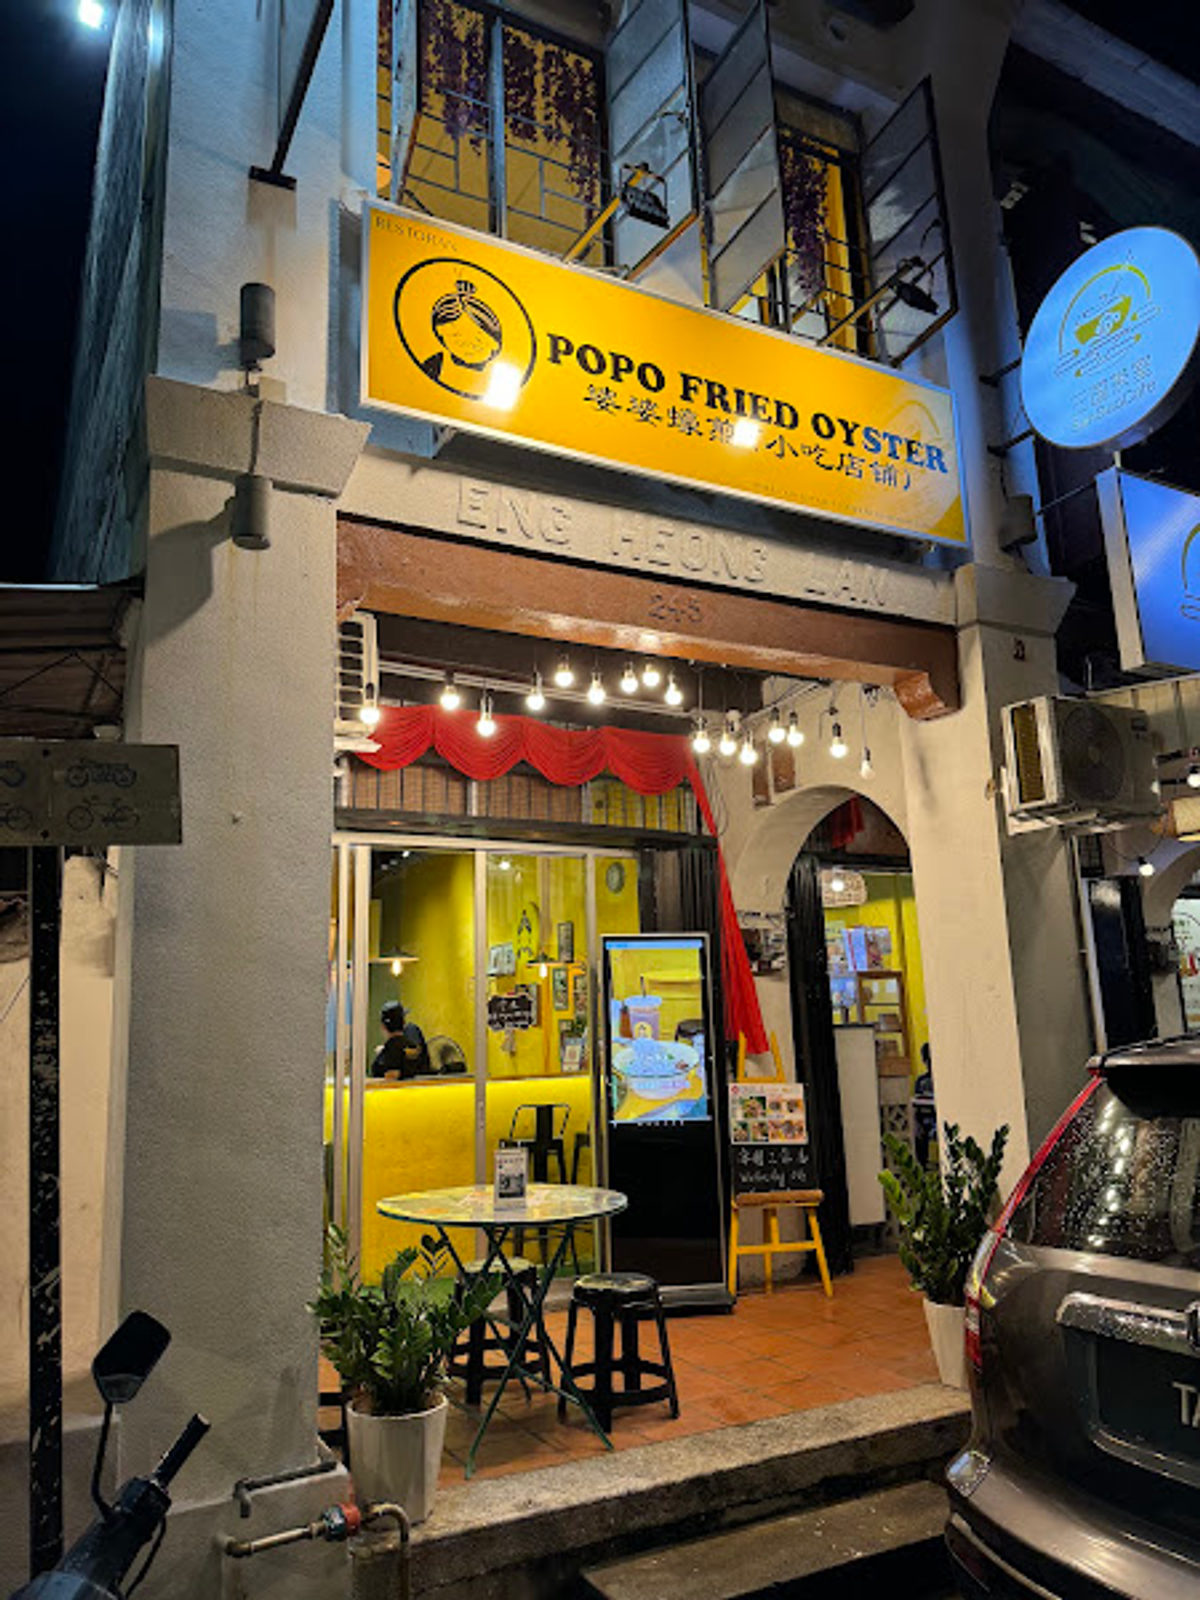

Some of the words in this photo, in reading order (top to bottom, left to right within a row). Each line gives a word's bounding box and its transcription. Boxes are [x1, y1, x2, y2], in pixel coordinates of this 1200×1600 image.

[546, 332, 667, 394] POPO
[679, 370, 799, 431] FRIED
[811, 412, 949, 475] OYSTER
[456, 475, 572, 548] ENG
